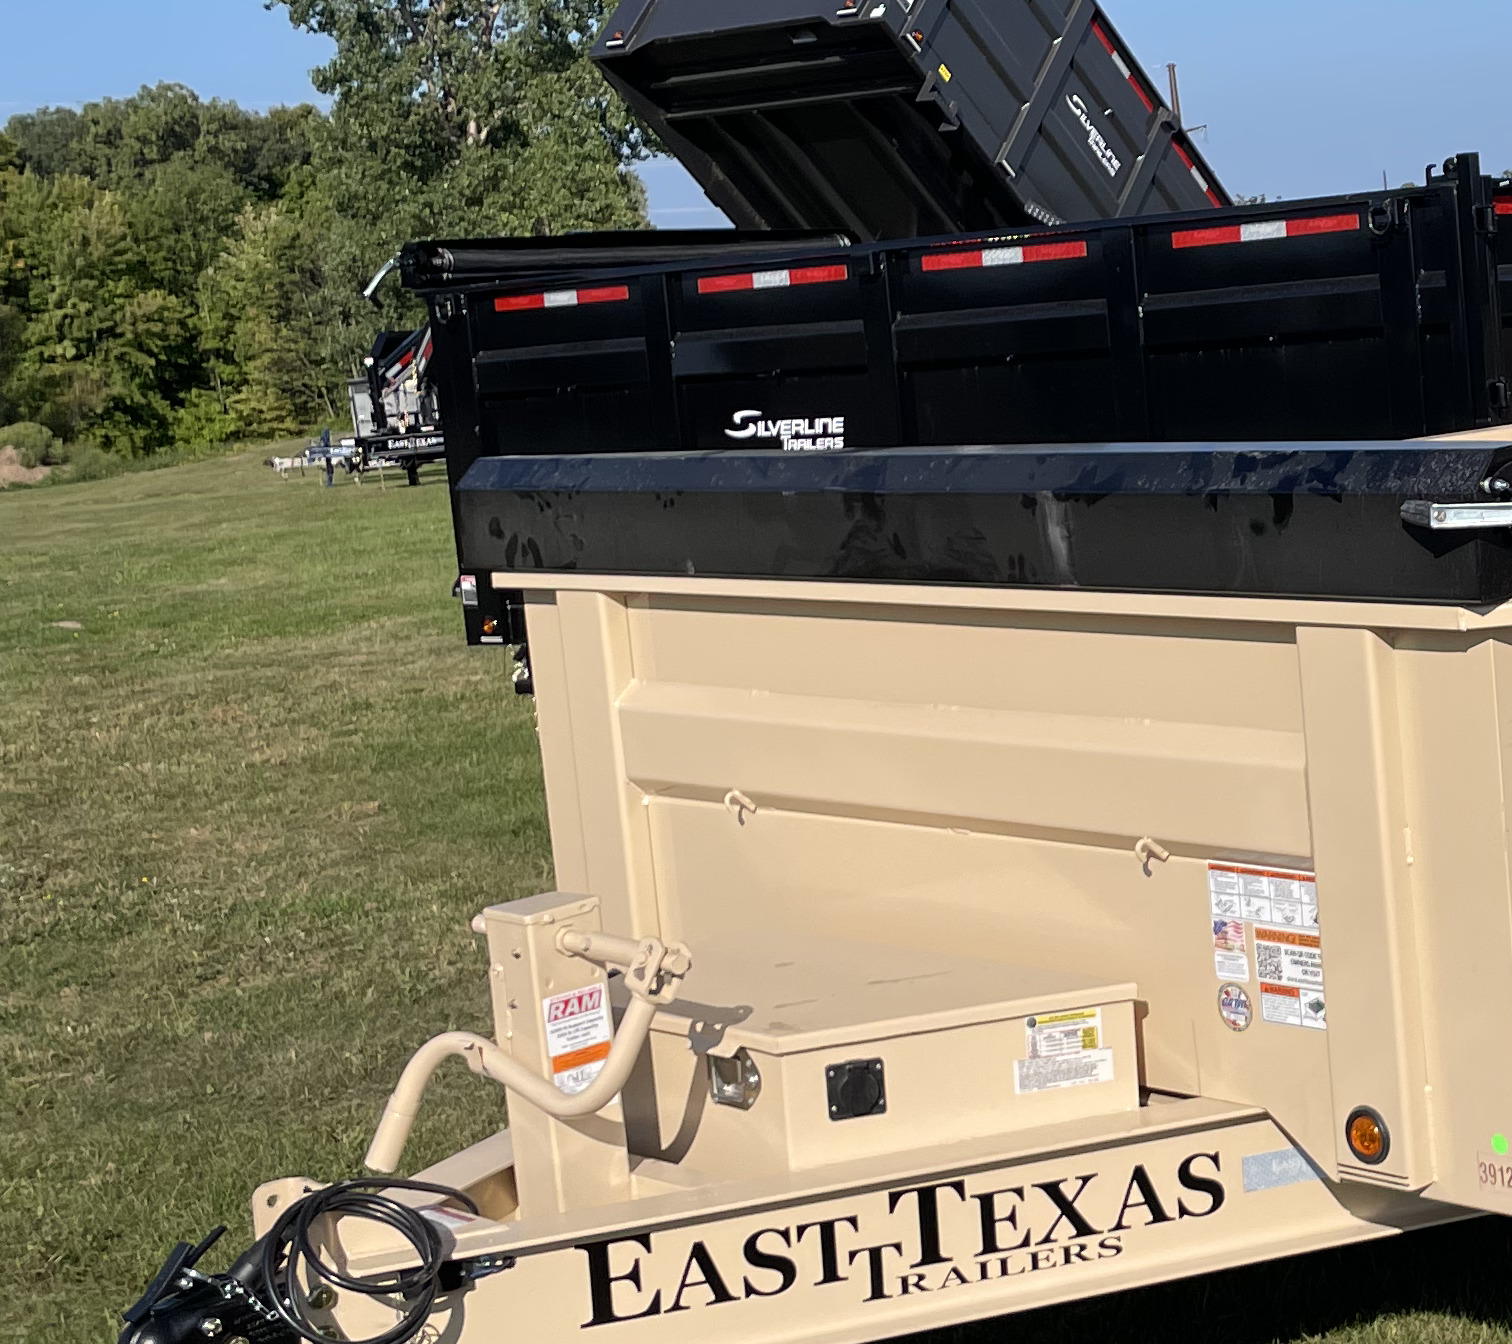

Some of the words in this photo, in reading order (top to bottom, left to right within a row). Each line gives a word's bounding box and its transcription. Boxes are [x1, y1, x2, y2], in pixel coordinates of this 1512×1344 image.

[1065, 94, 1121, 171] SILVERLINE
[724, 410, 844, 438] SILVERLINE
[780, 435, 844, 451] TRAILERS
[548, 990, 602, 1022] RAM
[574, 1215, 859, 1329] EAST
[888, 1151, 1226, 1269] TEXAS
[848, 1236, 1124, 1303] TRAILERS
